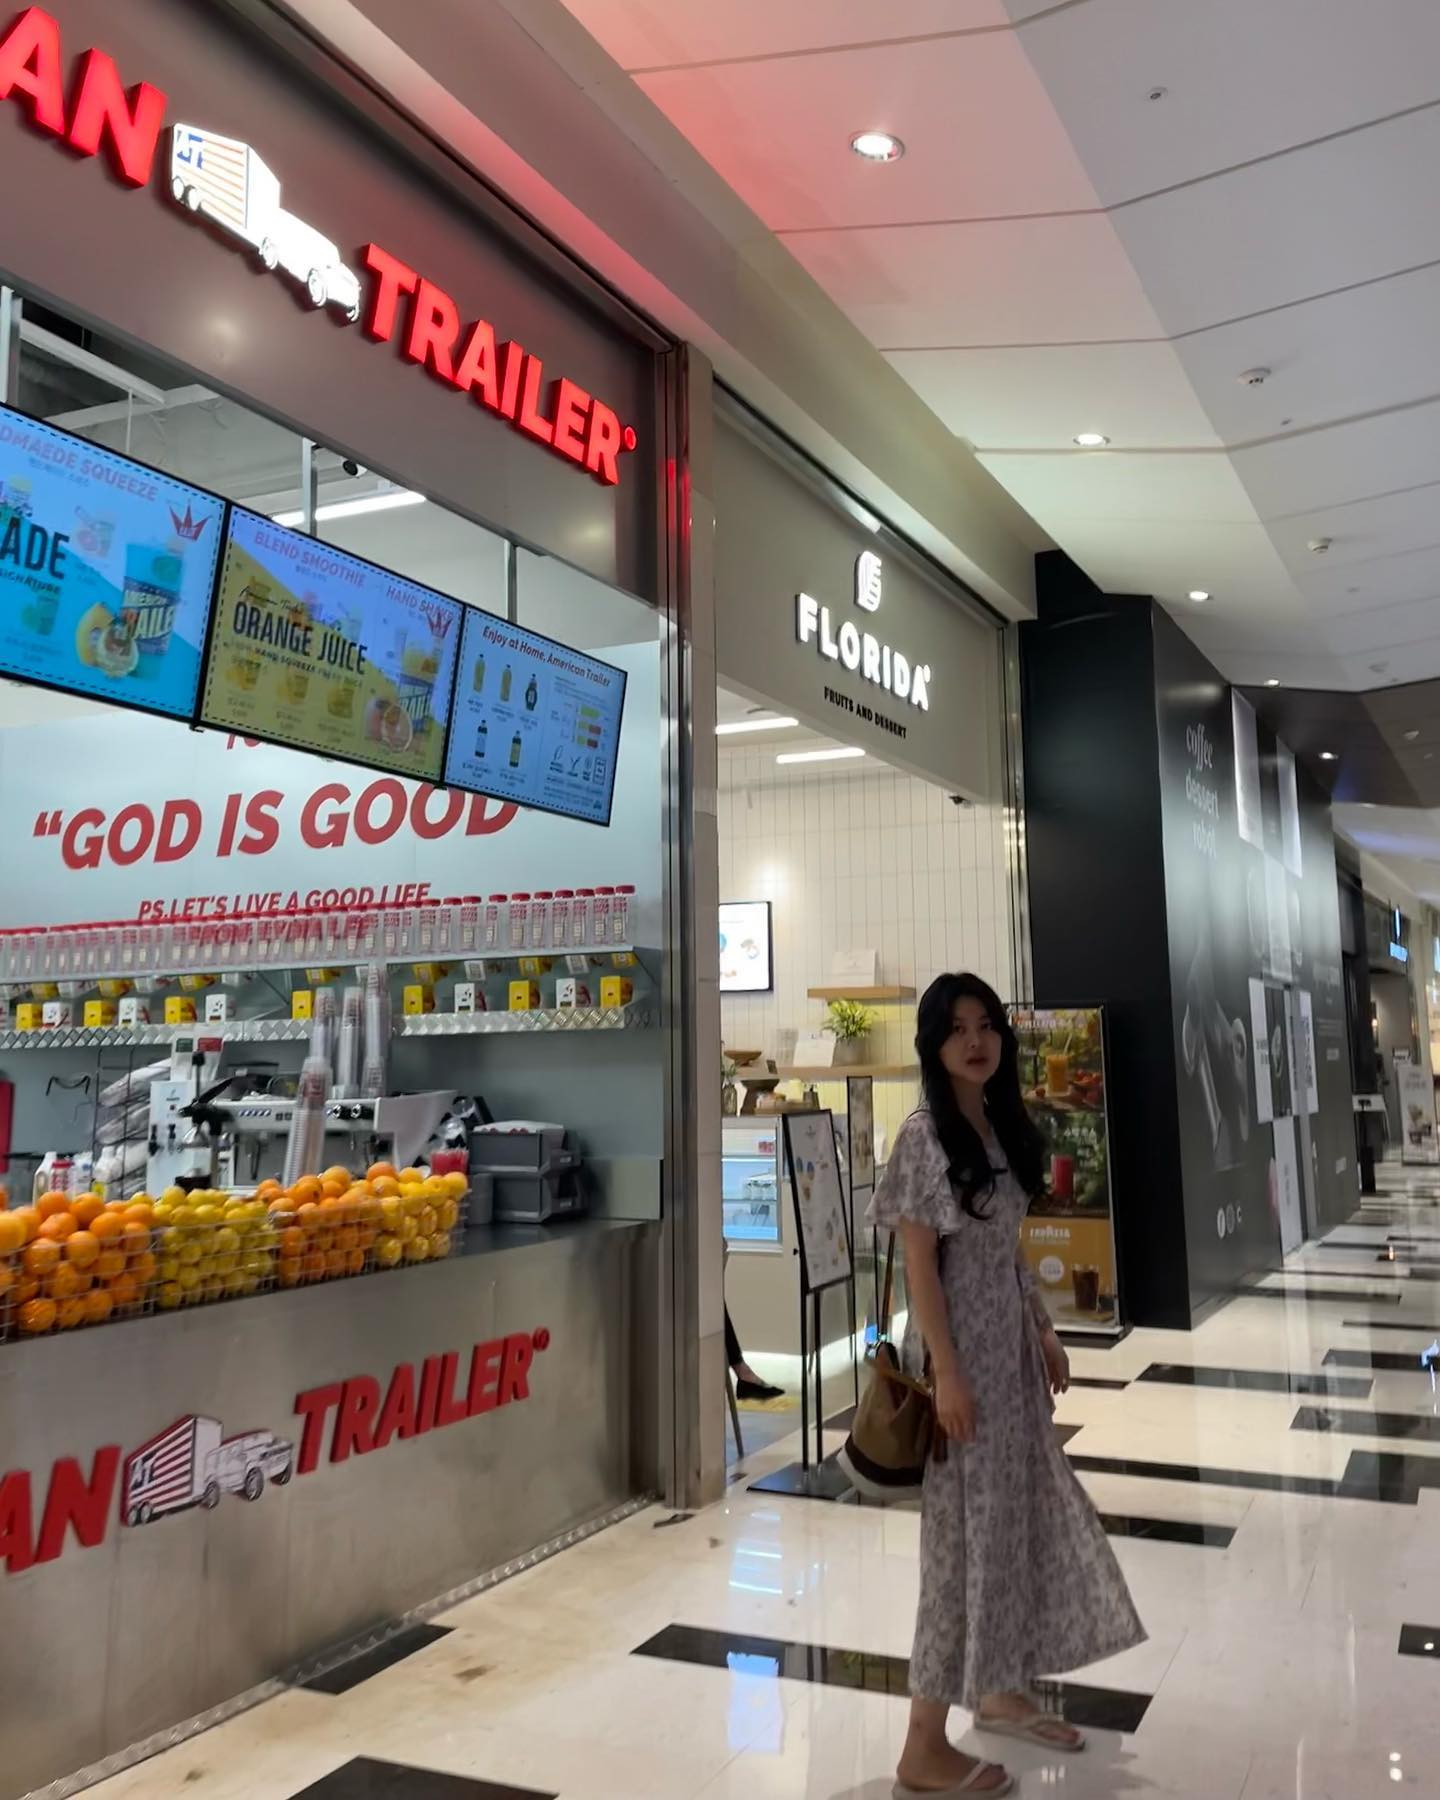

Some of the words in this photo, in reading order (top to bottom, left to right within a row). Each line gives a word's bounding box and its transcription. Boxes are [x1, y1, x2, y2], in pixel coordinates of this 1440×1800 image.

[0, 6, 168, 188] AN
[0, 516, 70, 580] ADE
[254, 530, 303, 560] BLEND
[301, 550, 367, 588] SMOOTHIE
[232, 600, 314, 658] ORANGE
[316, 630, 369, 676] JUICE
[482, 625, 508, 648] Enjoy
[508, 637, 519, 648] at
[546, 654, 587, 678] American
[586, 668, 612, 688] Trailer
[796, 592, 929, 712] FLORIDA
[824, 685, 854, 713] FRUITS
[856, 703, 873, 722] AND
[874, 711, 907, 740] DESSERT
[1185, 722, 1214, 771] coffee
[216, 789, 285, 857] IS
[1185, 767, 1220, 819] dessert
[232, 891, 282, 914] LIVE
[285, 890, 299, 911] A
[304, 885, 375, 909] GOOD
[0, 1443, 122, 1573] AN
